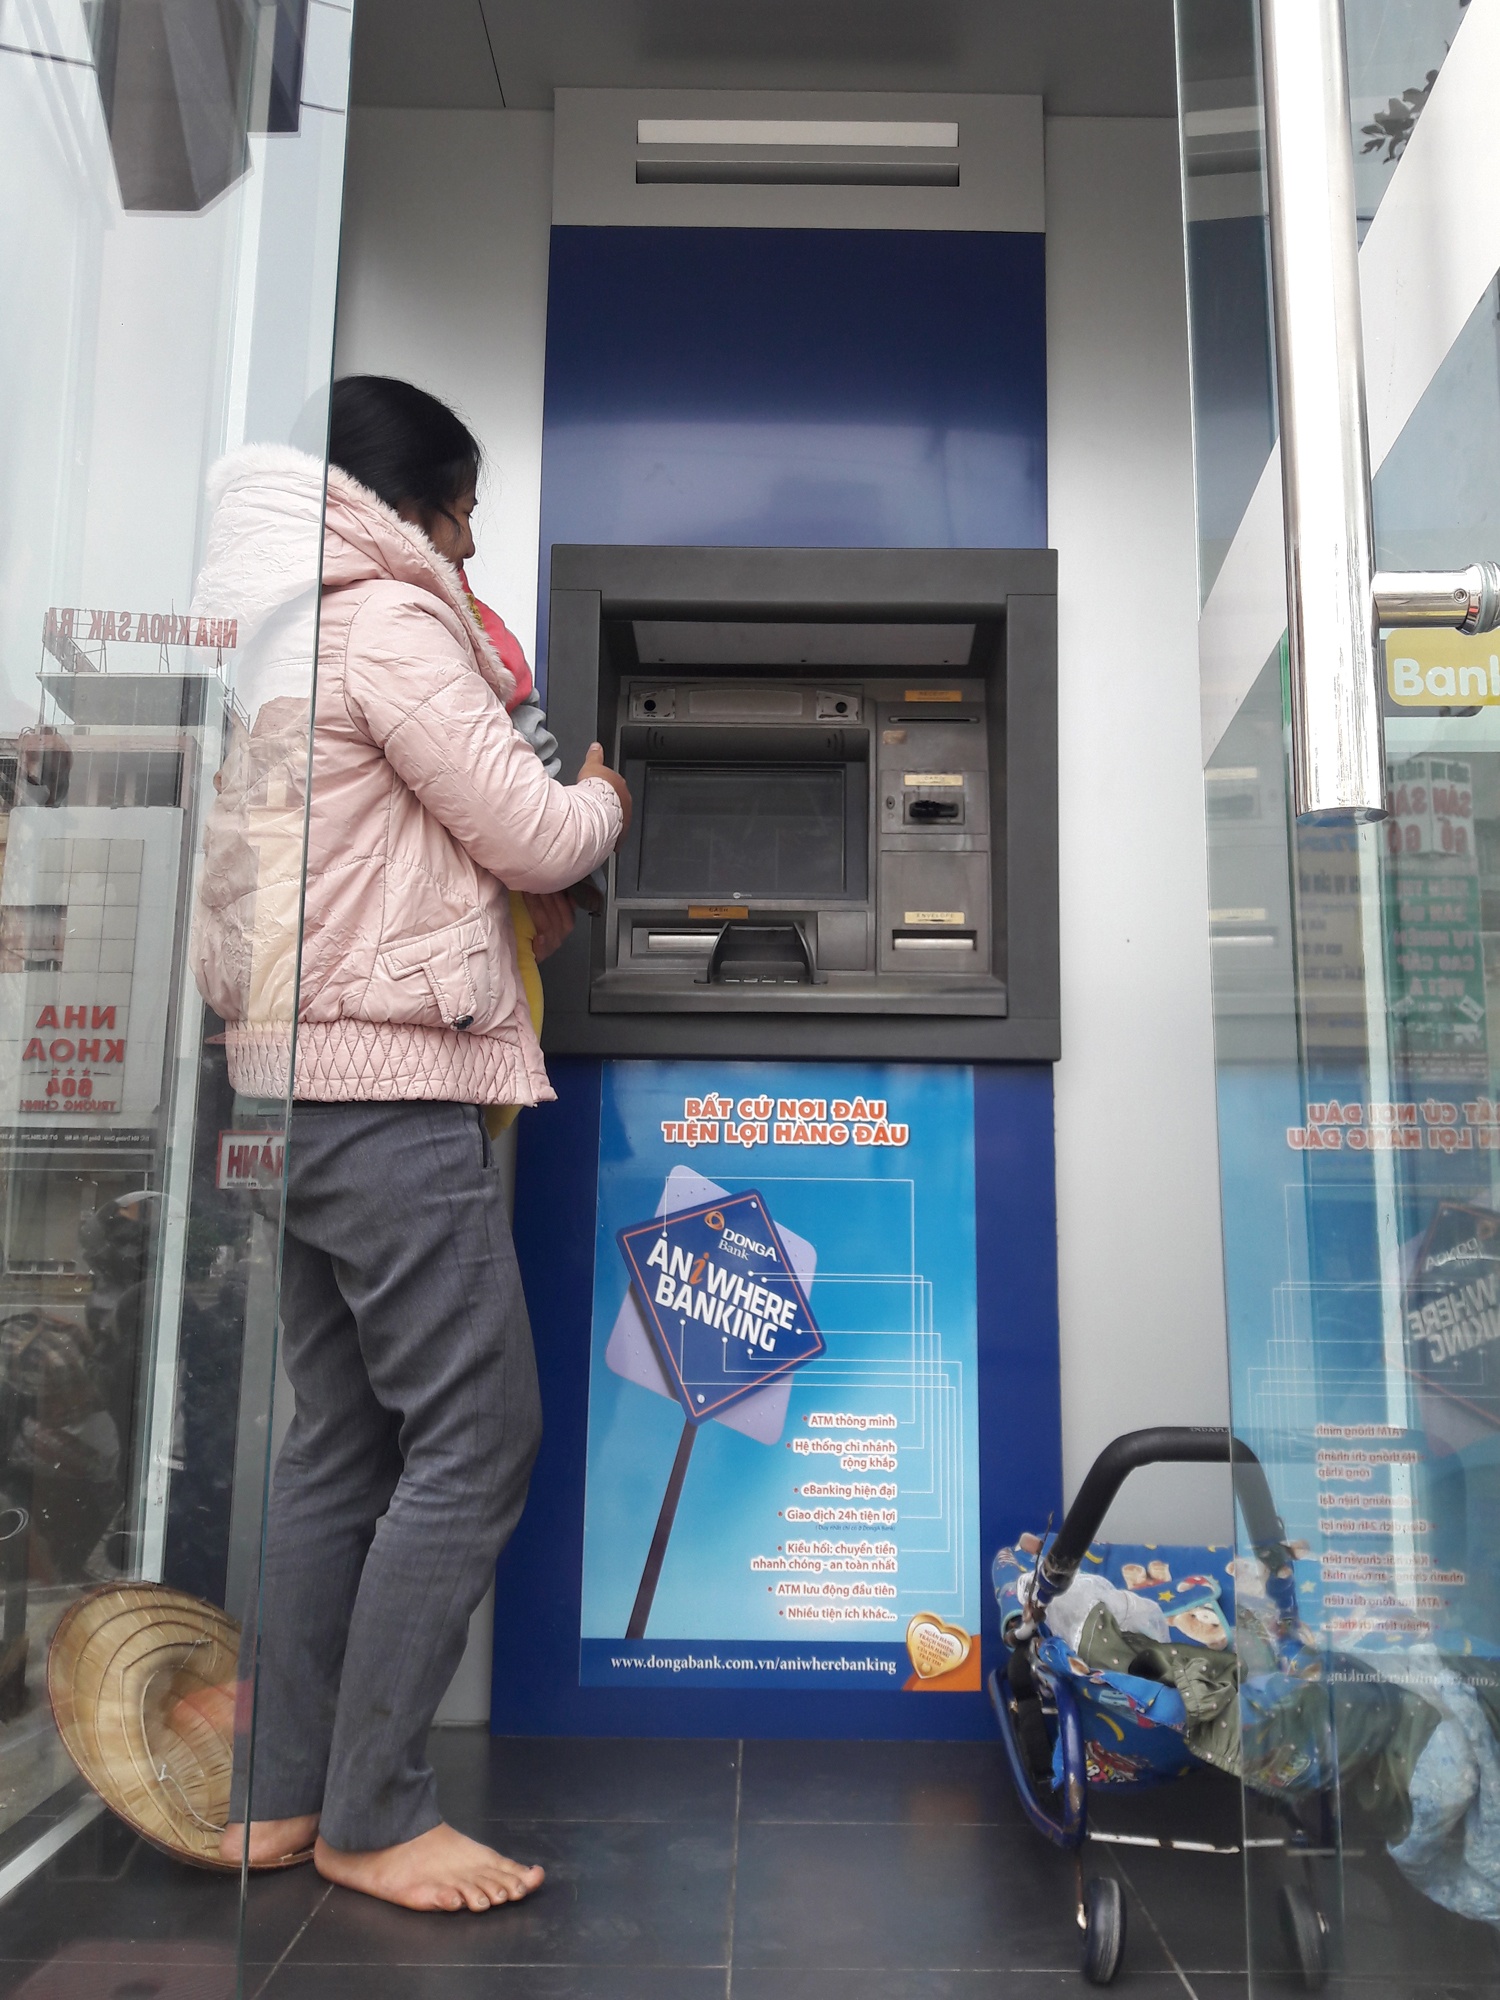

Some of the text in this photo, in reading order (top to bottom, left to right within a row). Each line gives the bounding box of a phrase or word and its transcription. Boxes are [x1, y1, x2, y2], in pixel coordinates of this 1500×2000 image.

[685, 1092, 886, 1120] BẤT CỨ NƠI ĐÂU
[661, 1120, 909, 1147] TIỆN LỢI HÀNG ĐẦU
[718, 1238, 750, 1261] Bank
[722, 1228, 779, 1262] DONGA
[654, 1273, 779, 1352] BANKING
[810, 1415, 896, 1428] ATM thông minh
[795, 1440, 896, 1454] Hệ thống chi nhánh
[842, 1455, 896, 1470] rộng khắp
[803, 1484, 896, 1498] eBanking hiện đại
[786, 1509, 896, 1523] Giao dịch 24h tiện lợi
[787, 1543, 896, 1556] Kiều hối: chuyển tiền
[753, 1558, 786, 1569] nhanh
[788, 1559, 822, 1571] chóng
[830, 1562, 843, 1570] an
[845, 1559, 869, 1570] toàn
[871, 1558, 896, 1571] nhất
[777, 1584, 895, 1598] ATM lưu động đầu tiên
[787, 1607, 896, 1621] Nhiều tiện ích khác...
[610, 1654, 898, 1675] www.dongabank.com.vn/aniwherebanking
